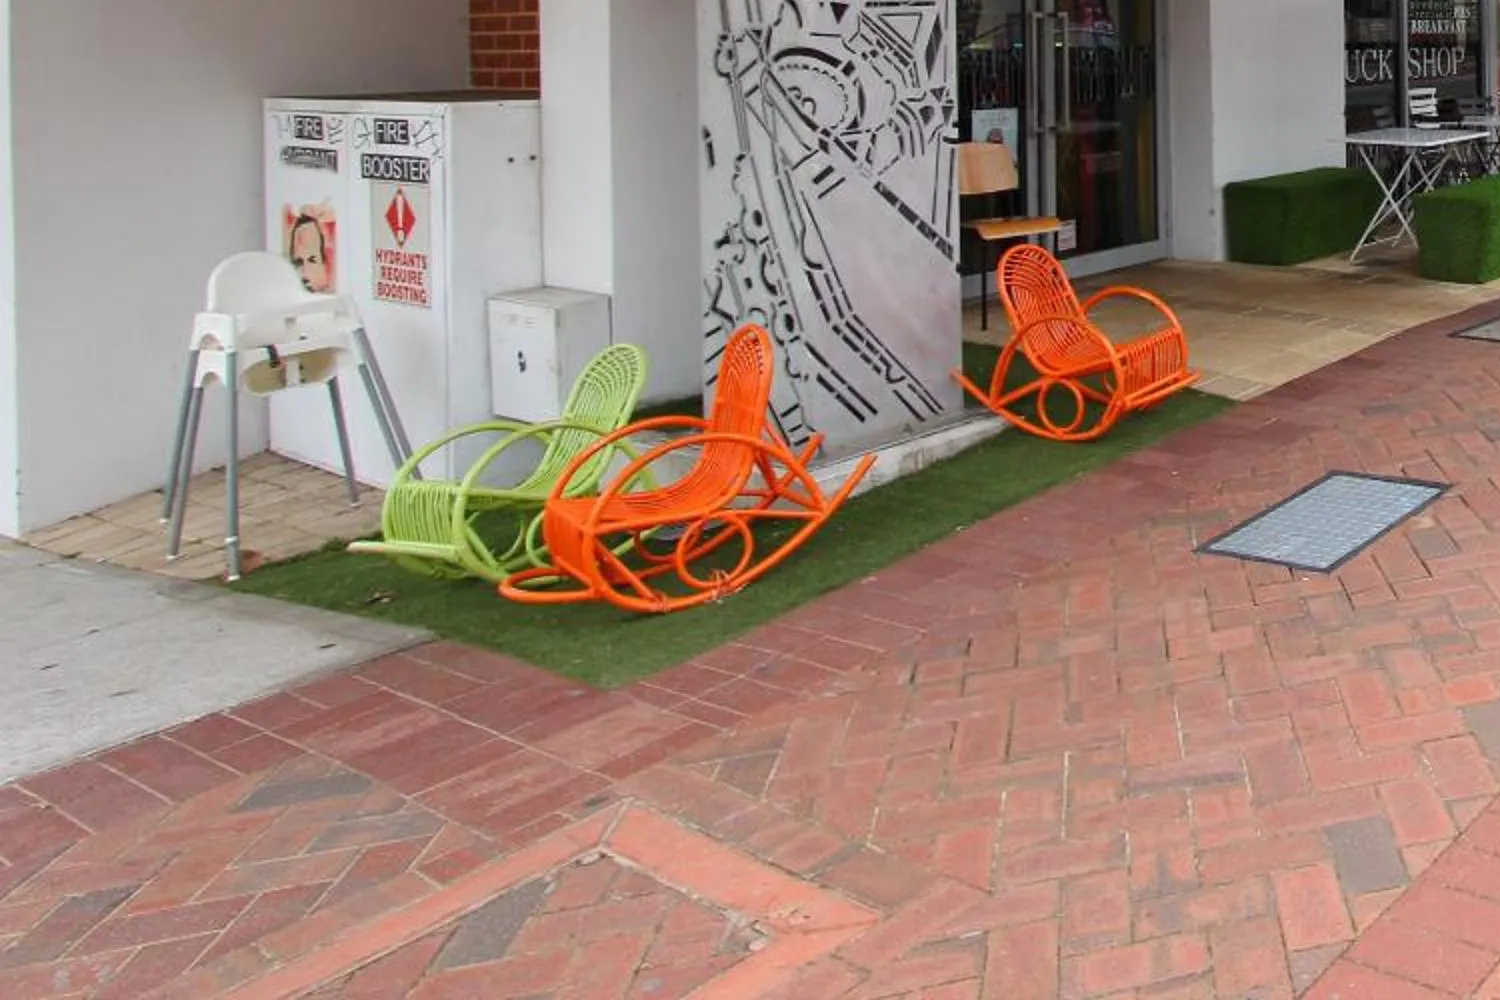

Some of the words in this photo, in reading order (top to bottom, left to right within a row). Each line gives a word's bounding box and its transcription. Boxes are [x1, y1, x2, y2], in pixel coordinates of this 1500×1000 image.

[1345, 49, 1393, 83] UCK
[1408, 47, 1465, 79] SHOP
[295, 117, 322, 139] FIRE
[375, 120, 408, 144] FIRE
[363, 155, 429, 181] BOOSTER
[376, 248, 427, 270] HYDRANTS
[381, 265, 423, 286] REQUIRE
[377, 282, 427, 303] BOOSTING
